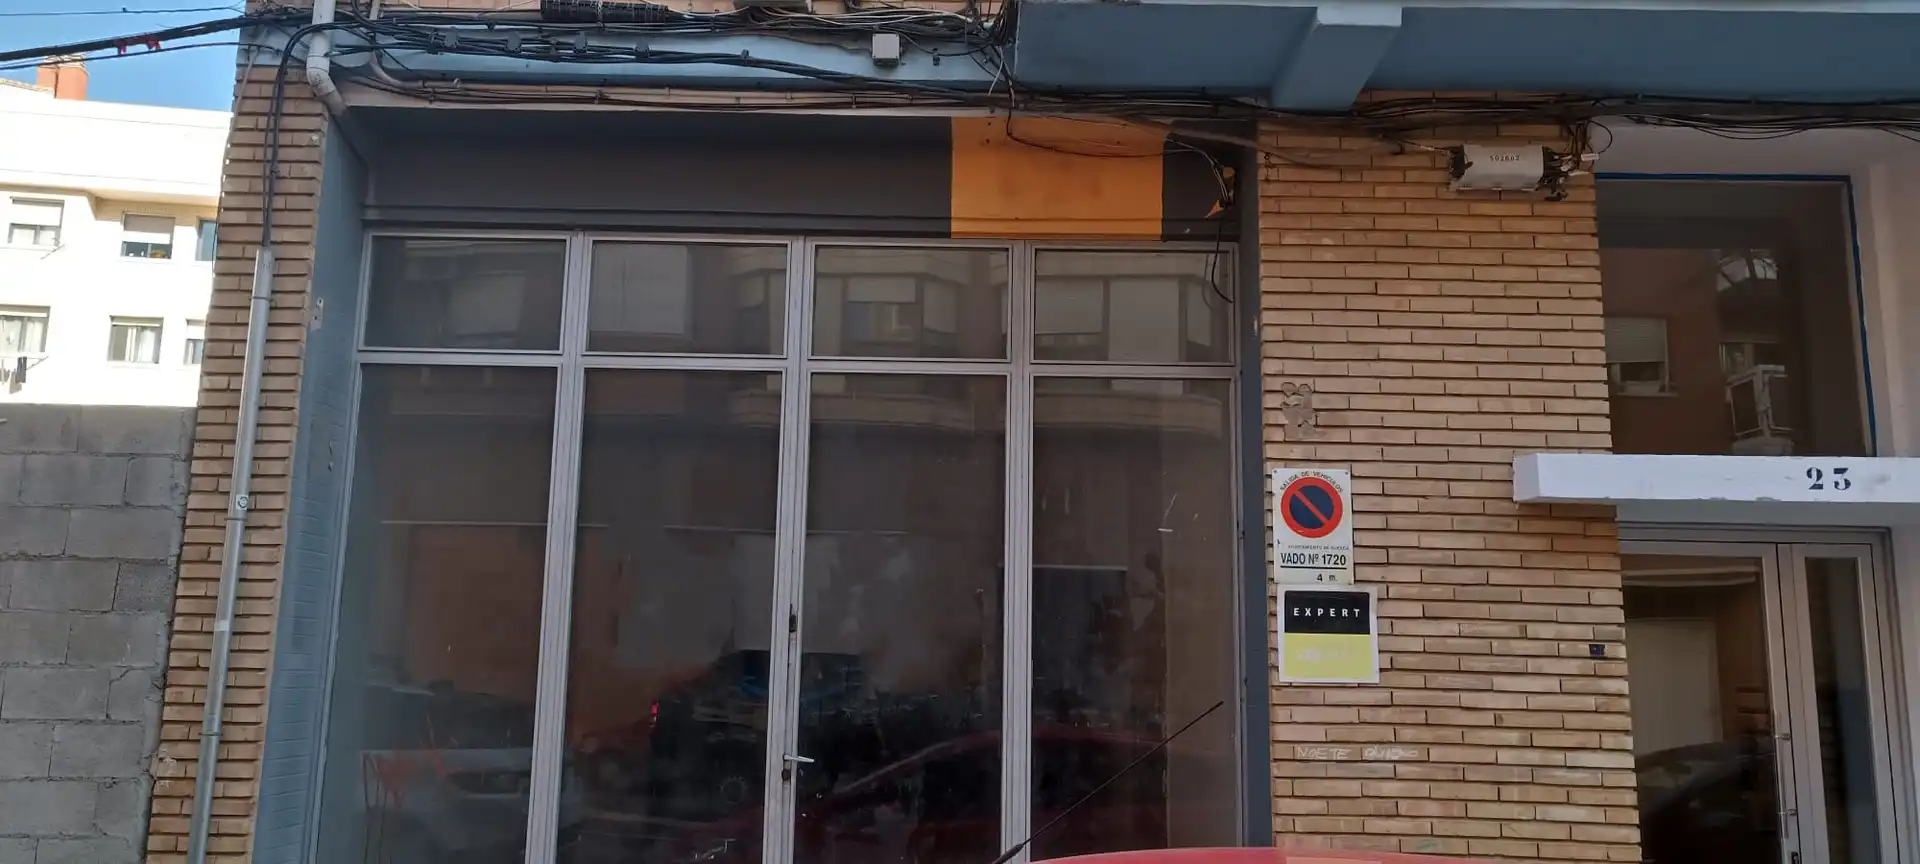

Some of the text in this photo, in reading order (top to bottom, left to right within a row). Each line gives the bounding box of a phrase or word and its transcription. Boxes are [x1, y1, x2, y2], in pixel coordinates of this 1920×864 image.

[1806, 466, 1851, 490] 23
[1280, 552, 1306, 565] VADO
[1321, 553, 1347, 566] 1720
[1316, 573, 1323, 582] 4
[1293, 607, 1360, 618] EXPERT
